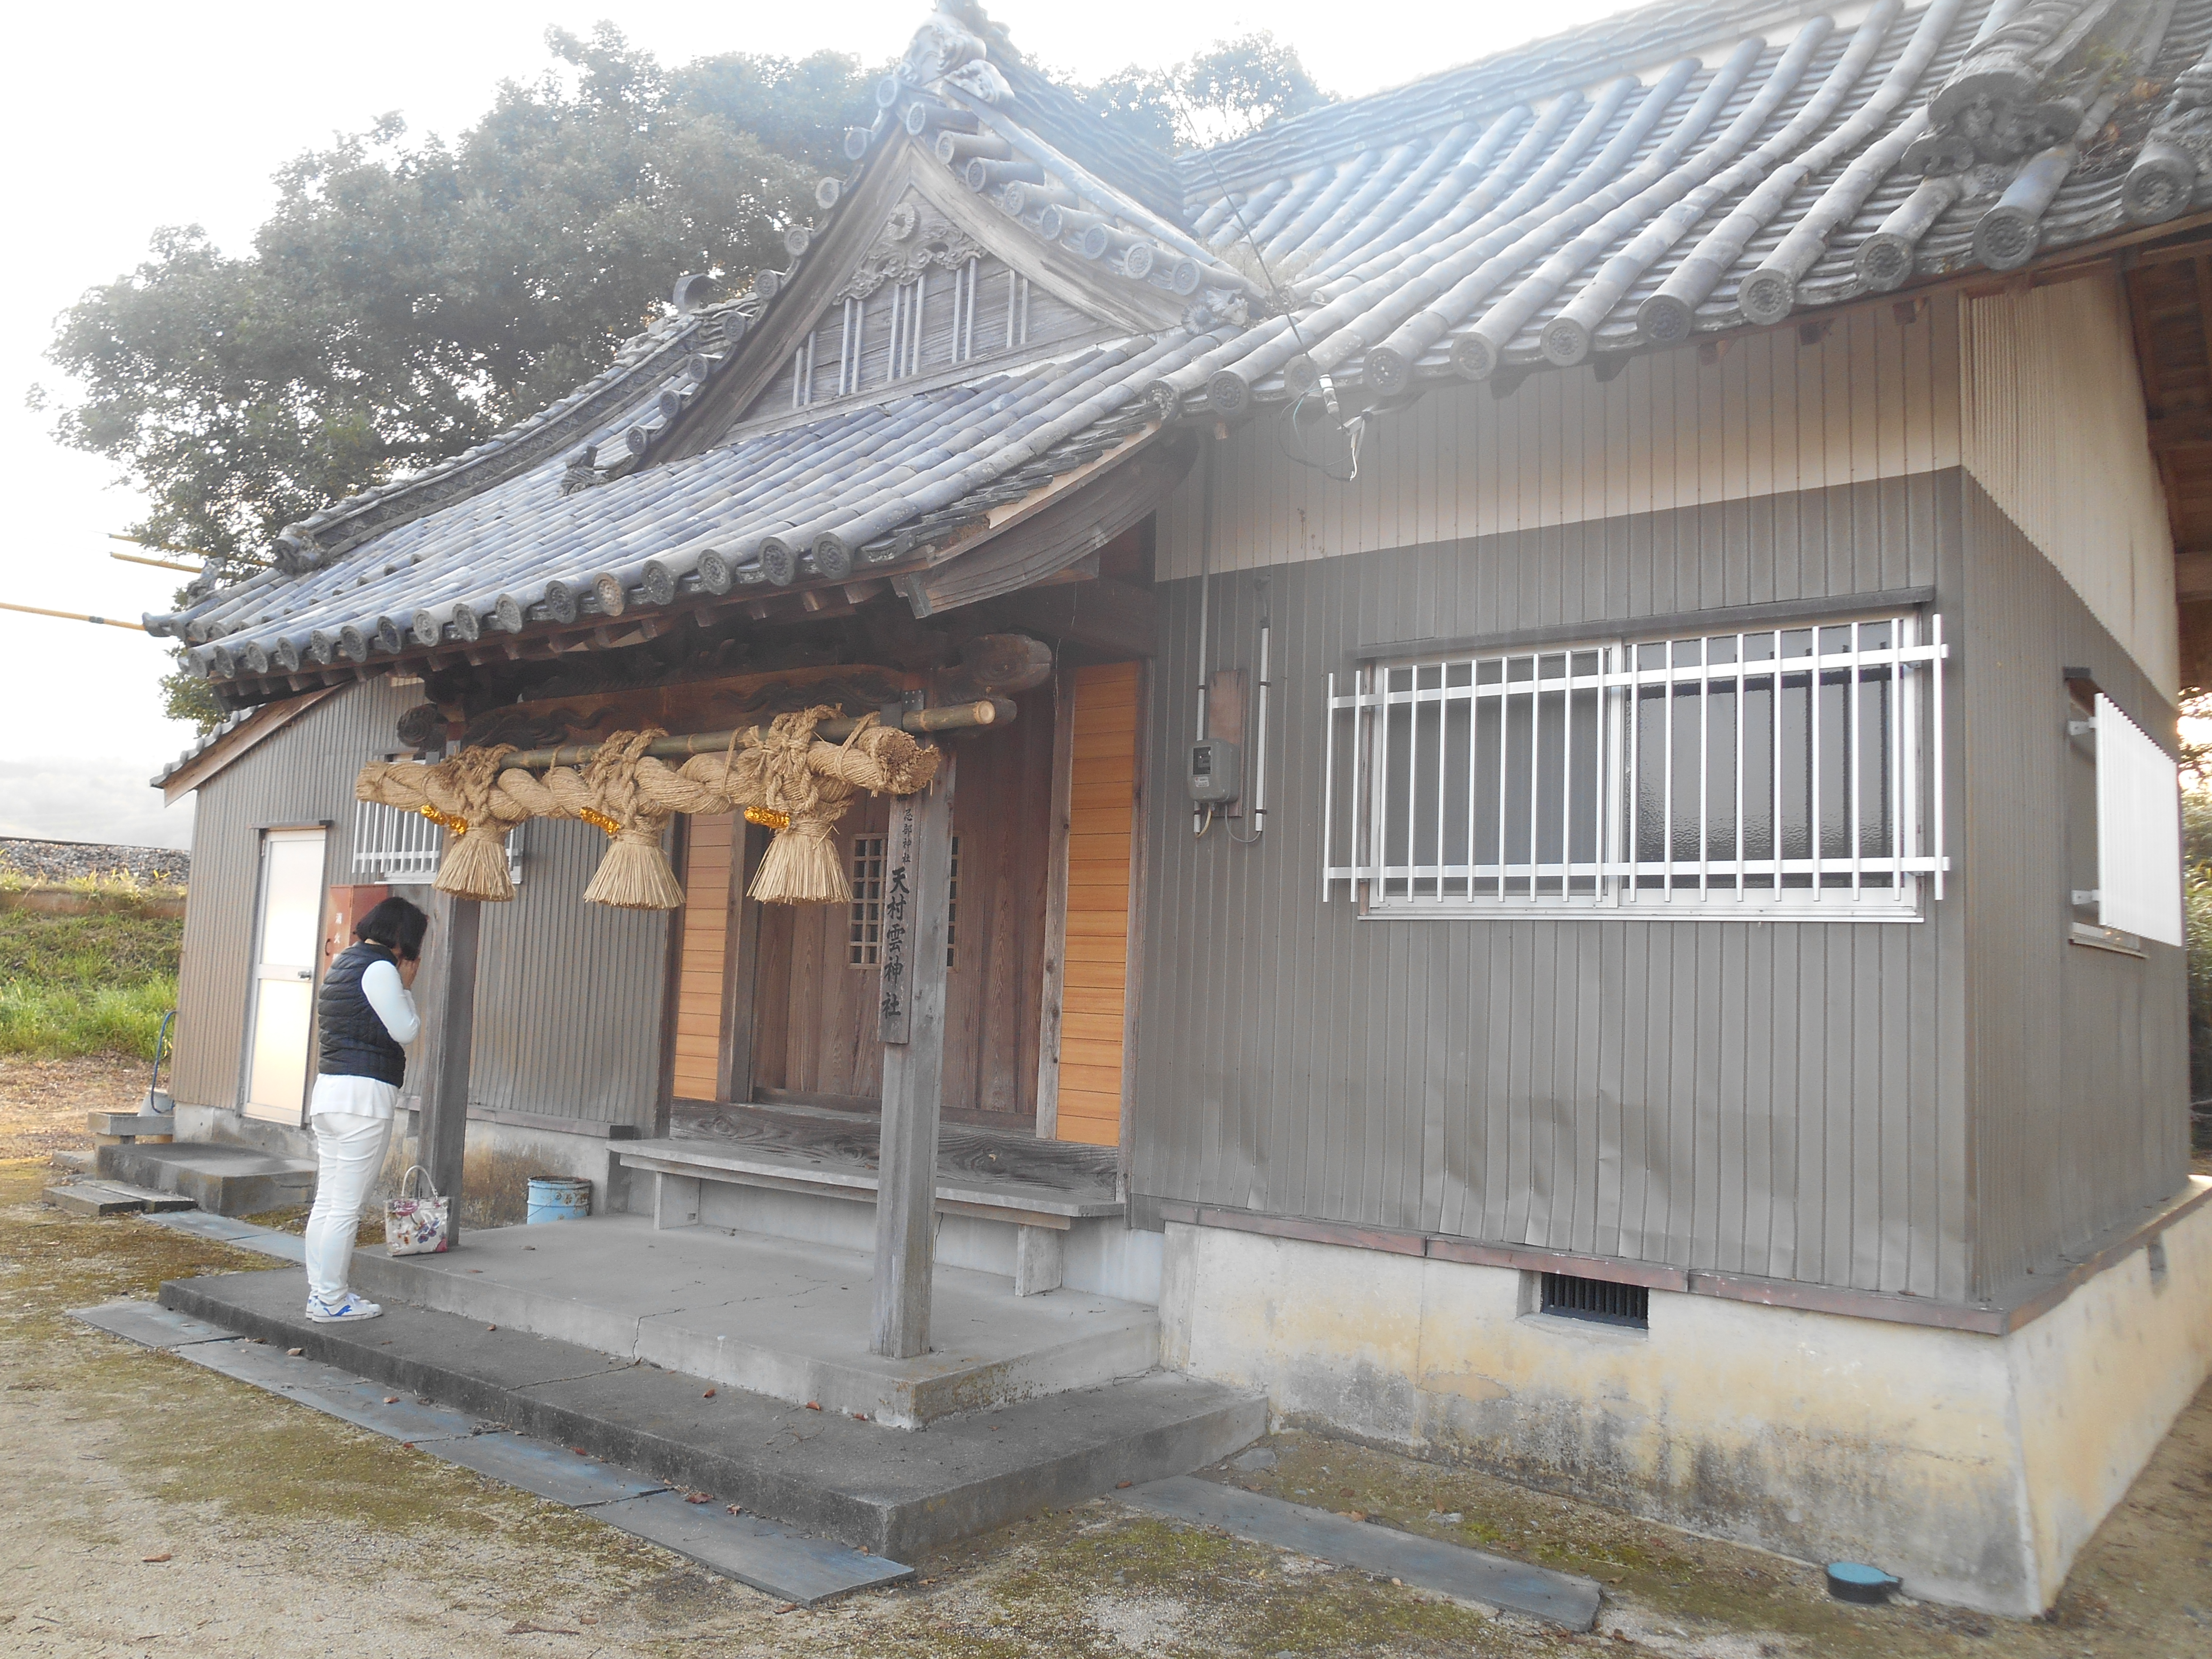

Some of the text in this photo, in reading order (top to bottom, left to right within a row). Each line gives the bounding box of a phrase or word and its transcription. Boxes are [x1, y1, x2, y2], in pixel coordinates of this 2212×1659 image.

[902, 808, 913, 864] 忌部神社
[333, 912, 343, 960] 消火
[881, 866, 910, 1020] 天村雲神社
